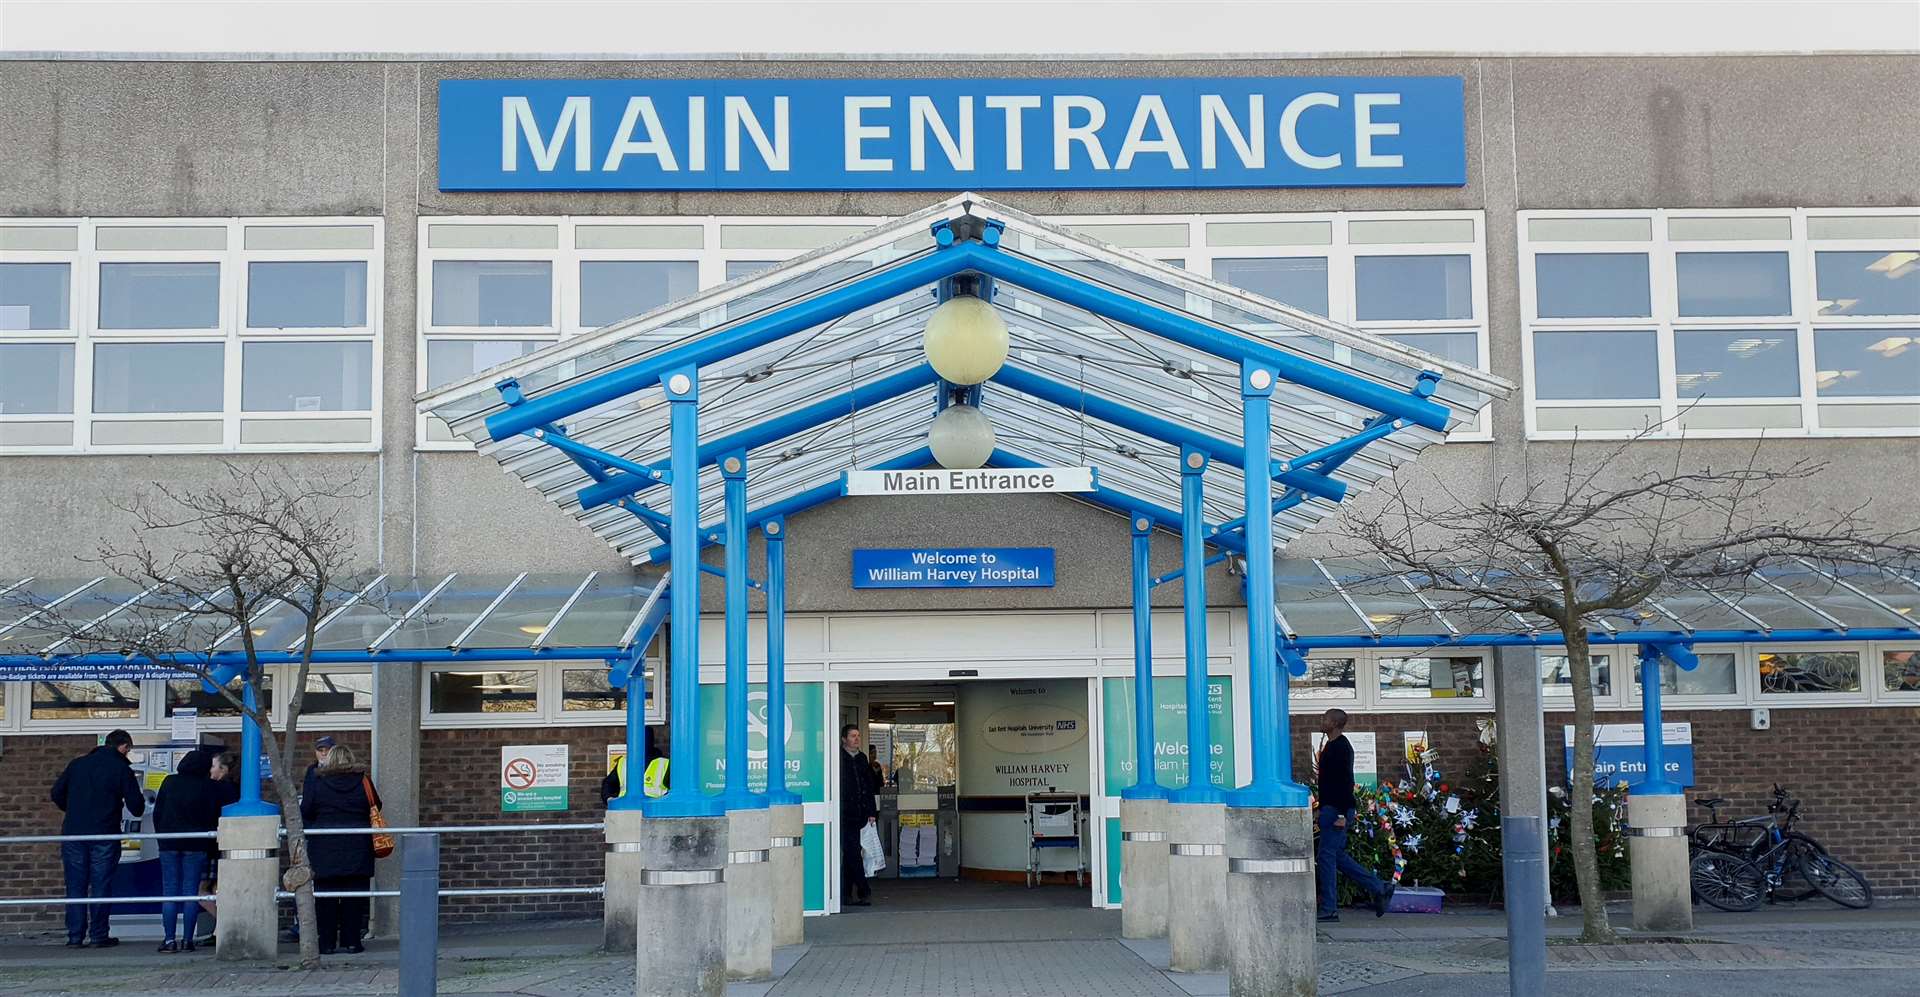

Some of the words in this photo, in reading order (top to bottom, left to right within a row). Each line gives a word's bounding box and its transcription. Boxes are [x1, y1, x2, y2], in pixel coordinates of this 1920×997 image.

[502, 95, 790, 172] MAIN
[844, 92, 1404, 171] ENTRANCE
[884, 472, 940, 491] Main
[950, 471, 1055, 490] Entrance
[912, 552, 977, 565] Welcome
[981, 552, 996, 564] to
[869, 567, 923, 581] William
[927, 568, 977, 583] Harvey
[981, 566, 1039, 583] Hospital
[83, 672, 98, 680] from
[151, 672, 171, 680] display
[1056, 720, 1076, 730] NHS
[1154, 741, 1223, 755] Welce
[716, 759, 726, 771] N
[995, 764, 1028, 775] WILLIAM
[1031, 763, 1069, 774] HARVEY
[1121, 760, 1133, 772] to
[1594, 761, 1616, 772] ain
[1009, 776, 1049, 788] HOSPITAL
